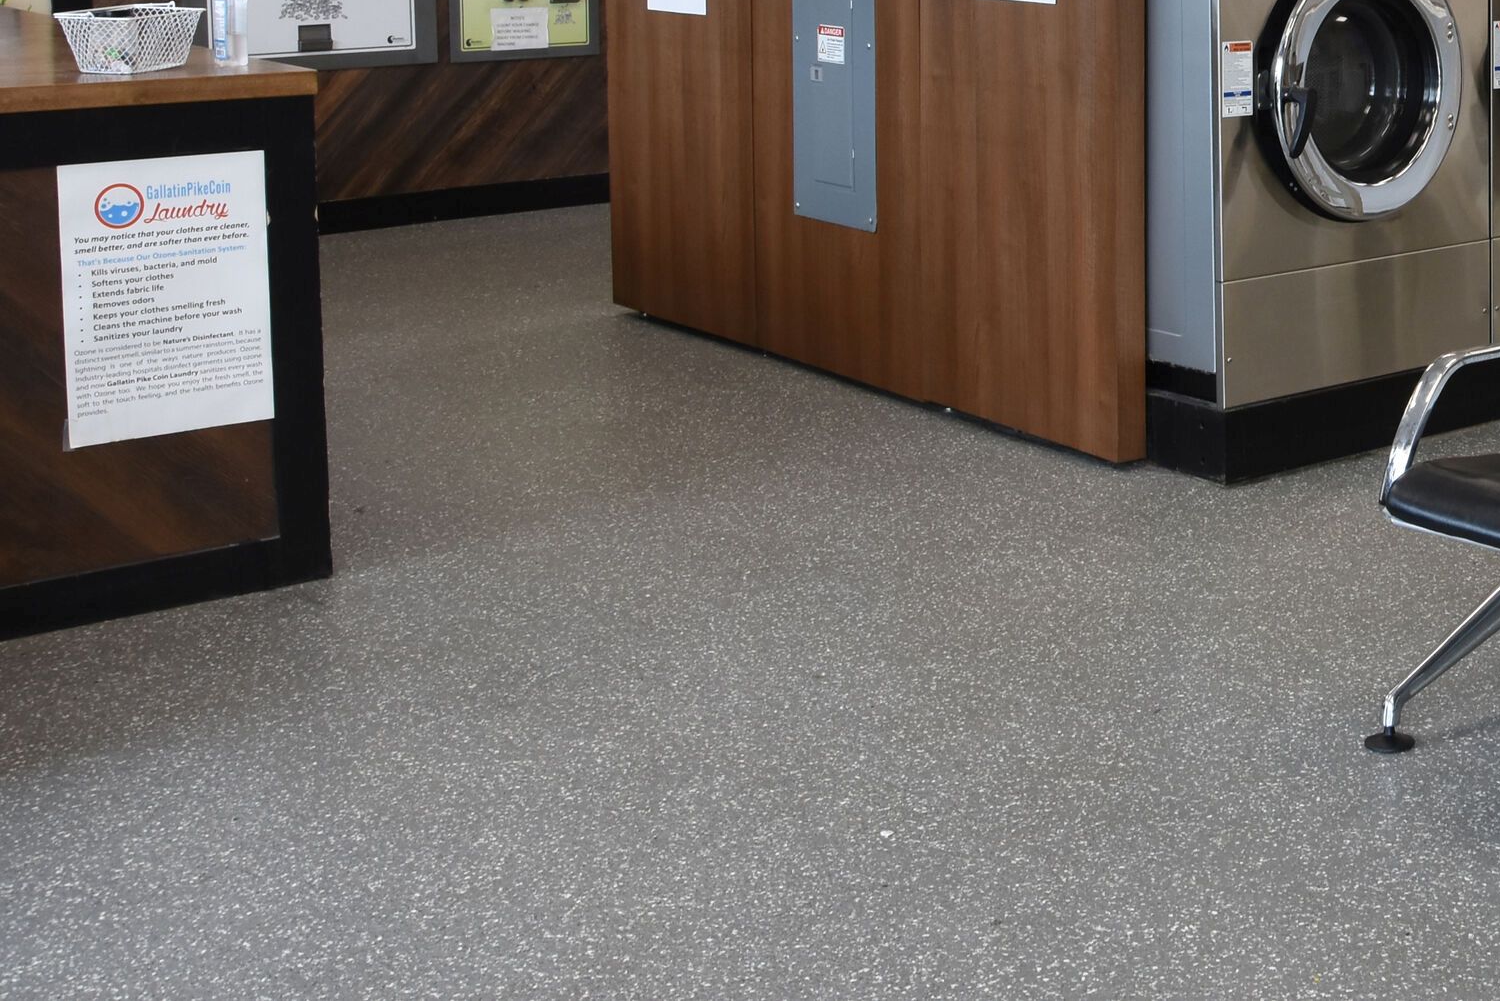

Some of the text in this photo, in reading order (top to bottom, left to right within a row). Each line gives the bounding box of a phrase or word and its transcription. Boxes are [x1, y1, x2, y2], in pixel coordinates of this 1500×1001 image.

[824, 27, 842, 36] DANGER
[146, 180, 230, 200] GallatinPikeCoin
[144, 199, 229, 223] Laundry
[73, 236, 89, 244] You
[90, 235, 109, 244] may
[110, 233, 136, 241] notice
[137, 230, 154, 239] that
[154, 230, 174, 239] your
[175, 226, 203, 235] clothes
[218, 223, 249, 231] cleaner,
[73, 245, 96, 255] smell
[97, 244, 125, 252] better,
[126, 241, 142, 250] and
[158, 238, 182, 247] softer
[183, 236, 202, 244] than
[221, 232, 249, 240] before.
[76, 258, 101, 267] That's
[102, 256, 134, 265] Because
[136, 253, 150, 261] Our
[217, 244, 246, 254] System:
[90, 256, 217, 277] Kills viruses, bacteria, and mold
[91, 272, 174, 288] Softens your clothes
[92, 283, 164, 299] Extends fabric life
[92, 297, 155, 310] Removes odors
[92, 297, 225, 321] Keeps your clothes smelling fresh
[92, 306, 242, 332] Cleans the machine before your wash
[93, 325, 183, 342] Sanitizes your laundry
[73, 349, 96, 357] Ozone
[105, 341, 142, 353] considered
[162, 336, 191, 346] Nature's
[75, 382, 88, 391] and
[106, 377, 135, 387] Gallatin
[136, 374, 151, 383] Pike
[152, 373, 168, 381] Coin
[169, 369, 198, 379] Laundry
[199, 366, 226, 375] sanitizes
[245, 360, 262, 369] wash
